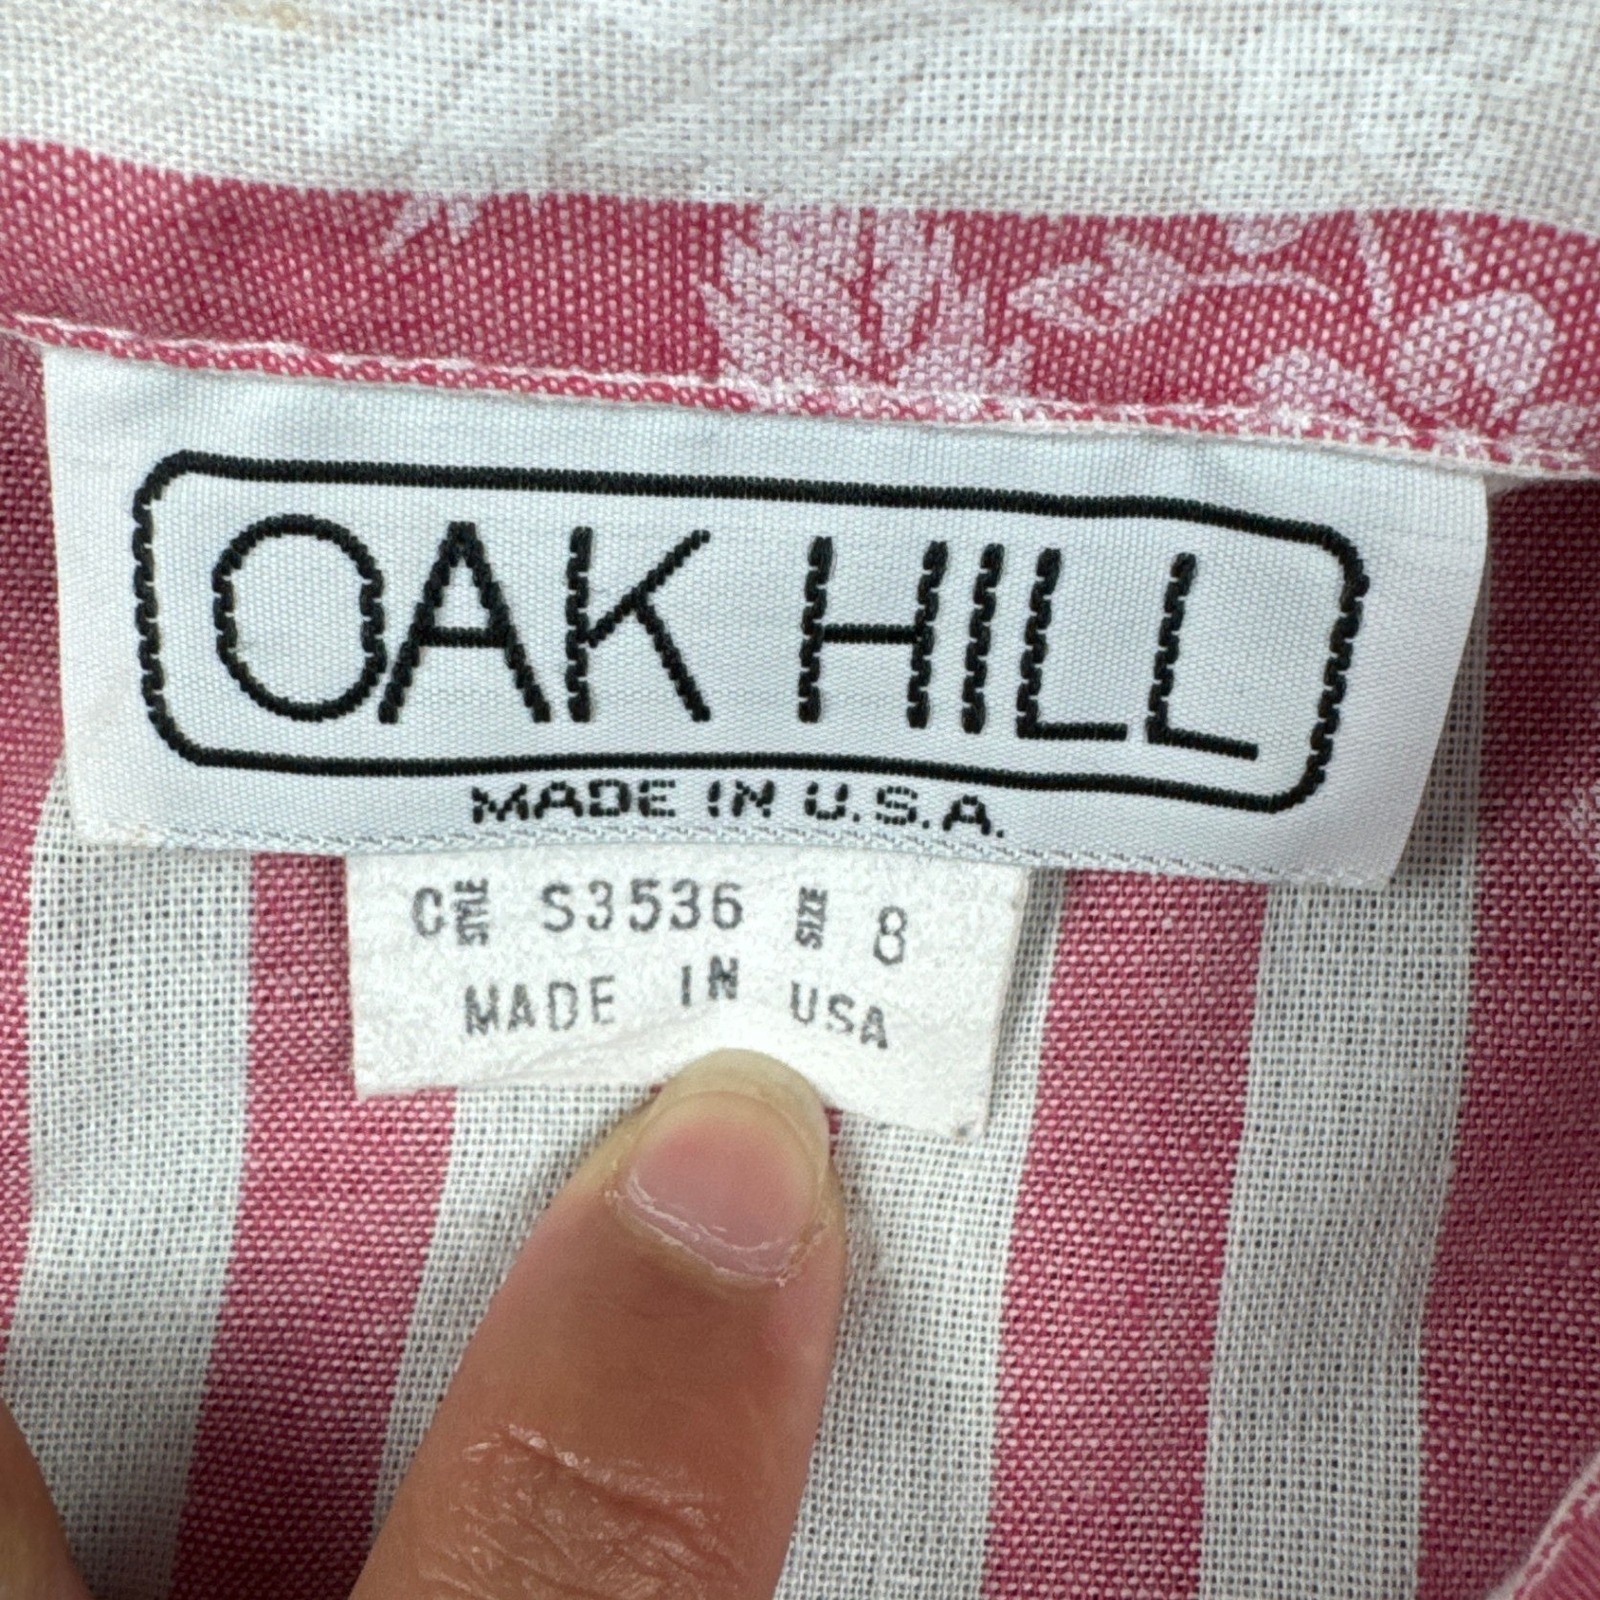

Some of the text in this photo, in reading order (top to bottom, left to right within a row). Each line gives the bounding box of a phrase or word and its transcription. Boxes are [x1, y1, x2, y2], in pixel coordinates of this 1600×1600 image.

[213, 512, 1260, 761] OAK HILL
[471, 779, 1005, 839] MADE IN U.S.A.
[541, 879, 744, 934] S3536
[795, 886, 828, 950] SIZE
[873, 905, 908, 966] 8
[464, 955, 890, 1050] MADE IN USA
